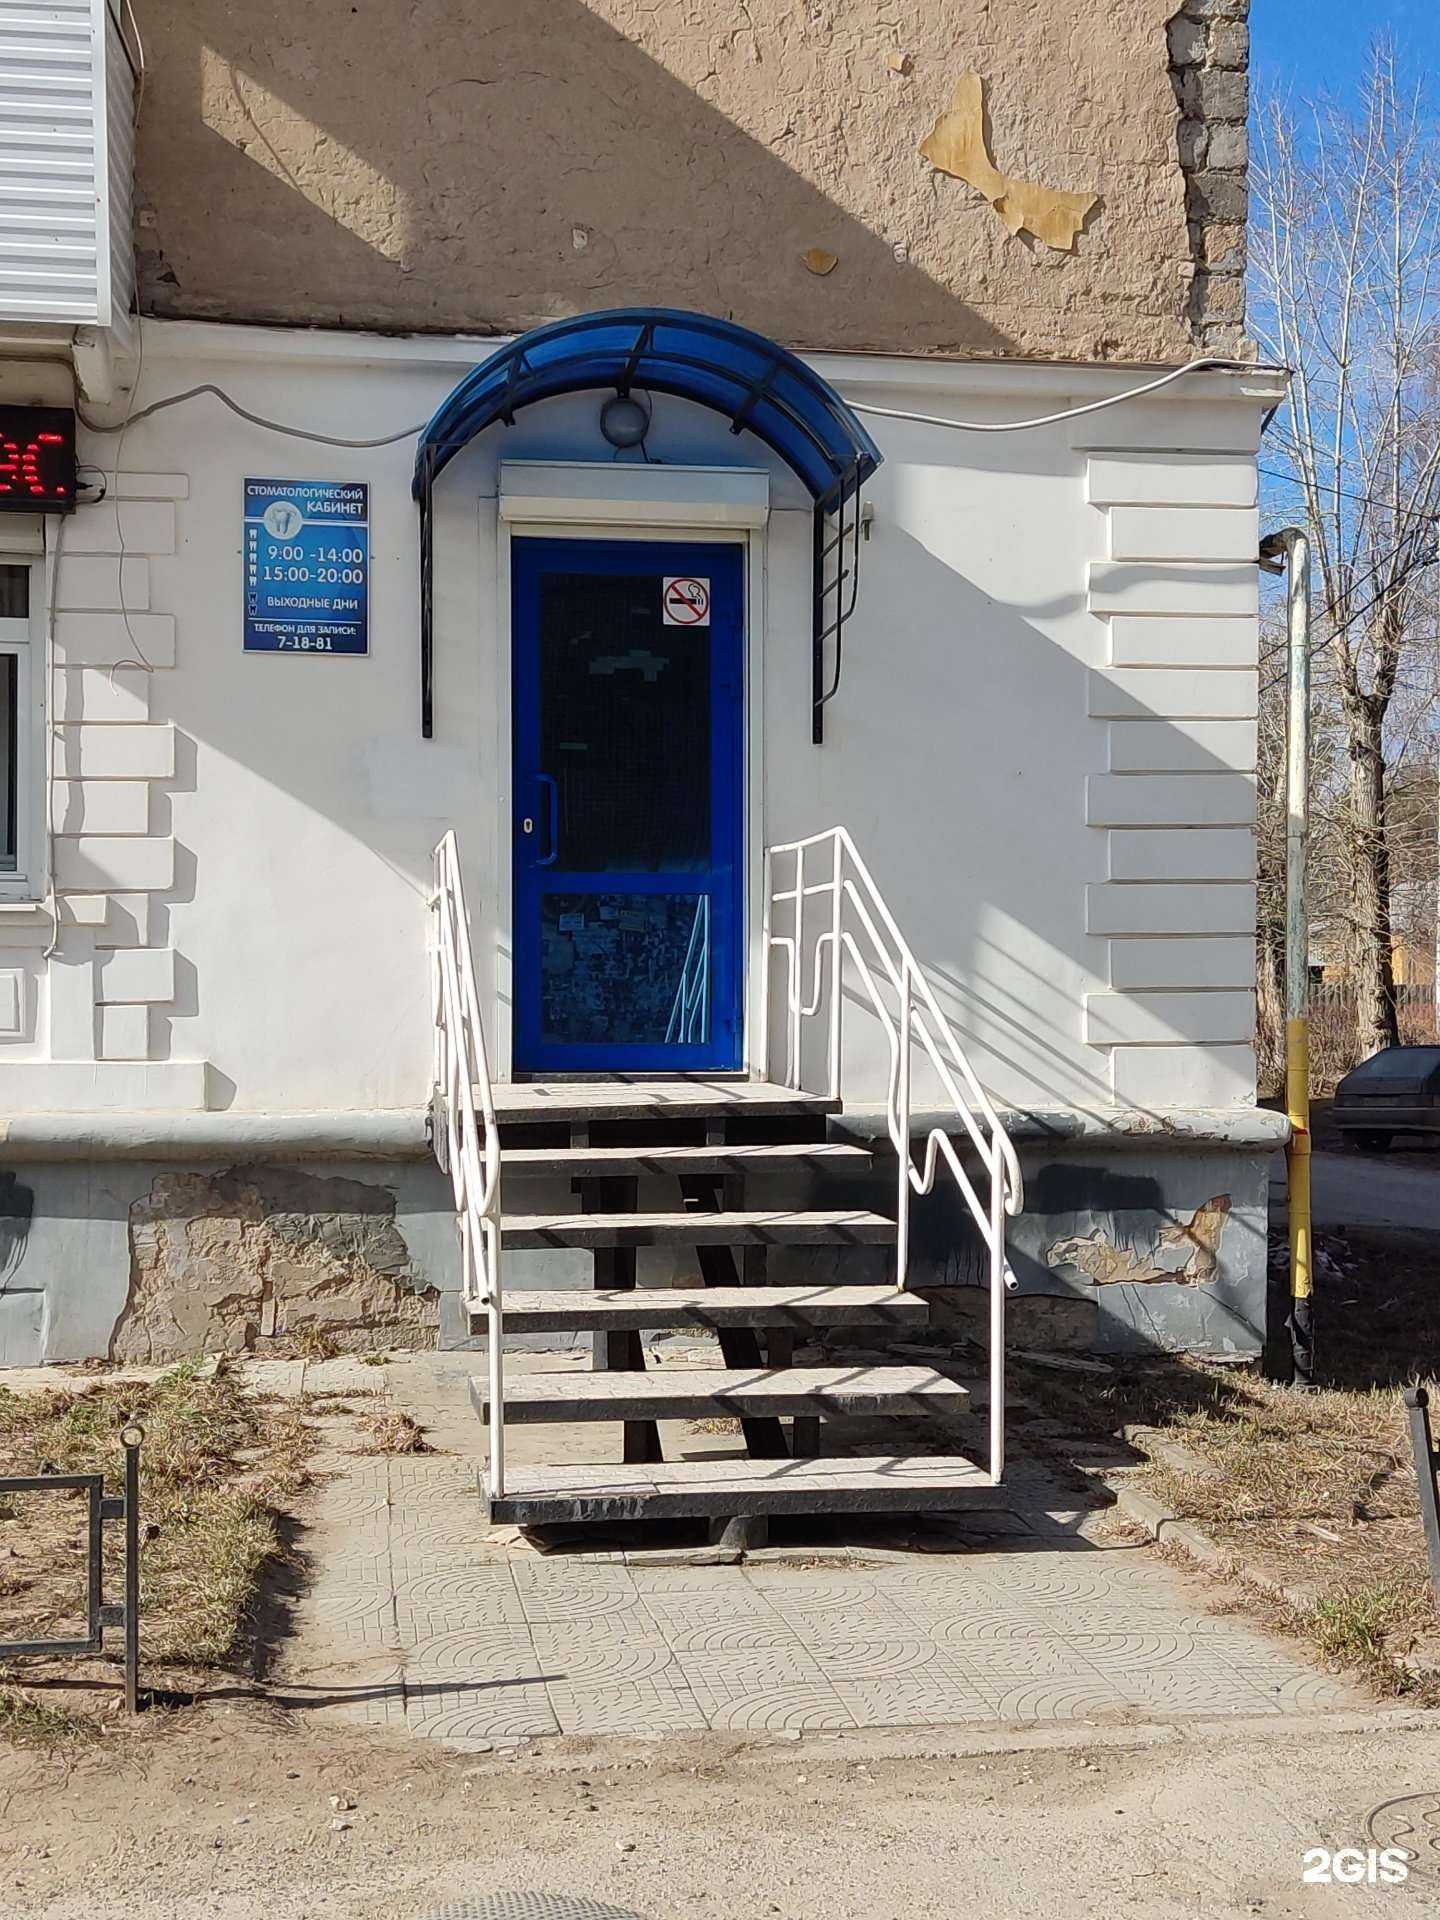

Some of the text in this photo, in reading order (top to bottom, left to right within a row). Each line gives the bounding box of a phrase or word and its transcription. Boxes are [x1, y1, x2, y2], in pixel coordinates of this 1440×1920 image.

[247, 485, 363, 499] СТОМАТОЛОГИЧЕСКИЙ
[307, 501, 363, 514] КАБИНЕТ
[268, 546, 304, 560] 9:00
[267, 596, 358, 610] ВЫХОДНЫЕ ДНИ
[255, 623, 356, 635] ТЕЛЕФОН ДЛЯ ЗАПИСИ:
[277, 636, 332, 650] 7-18-81
